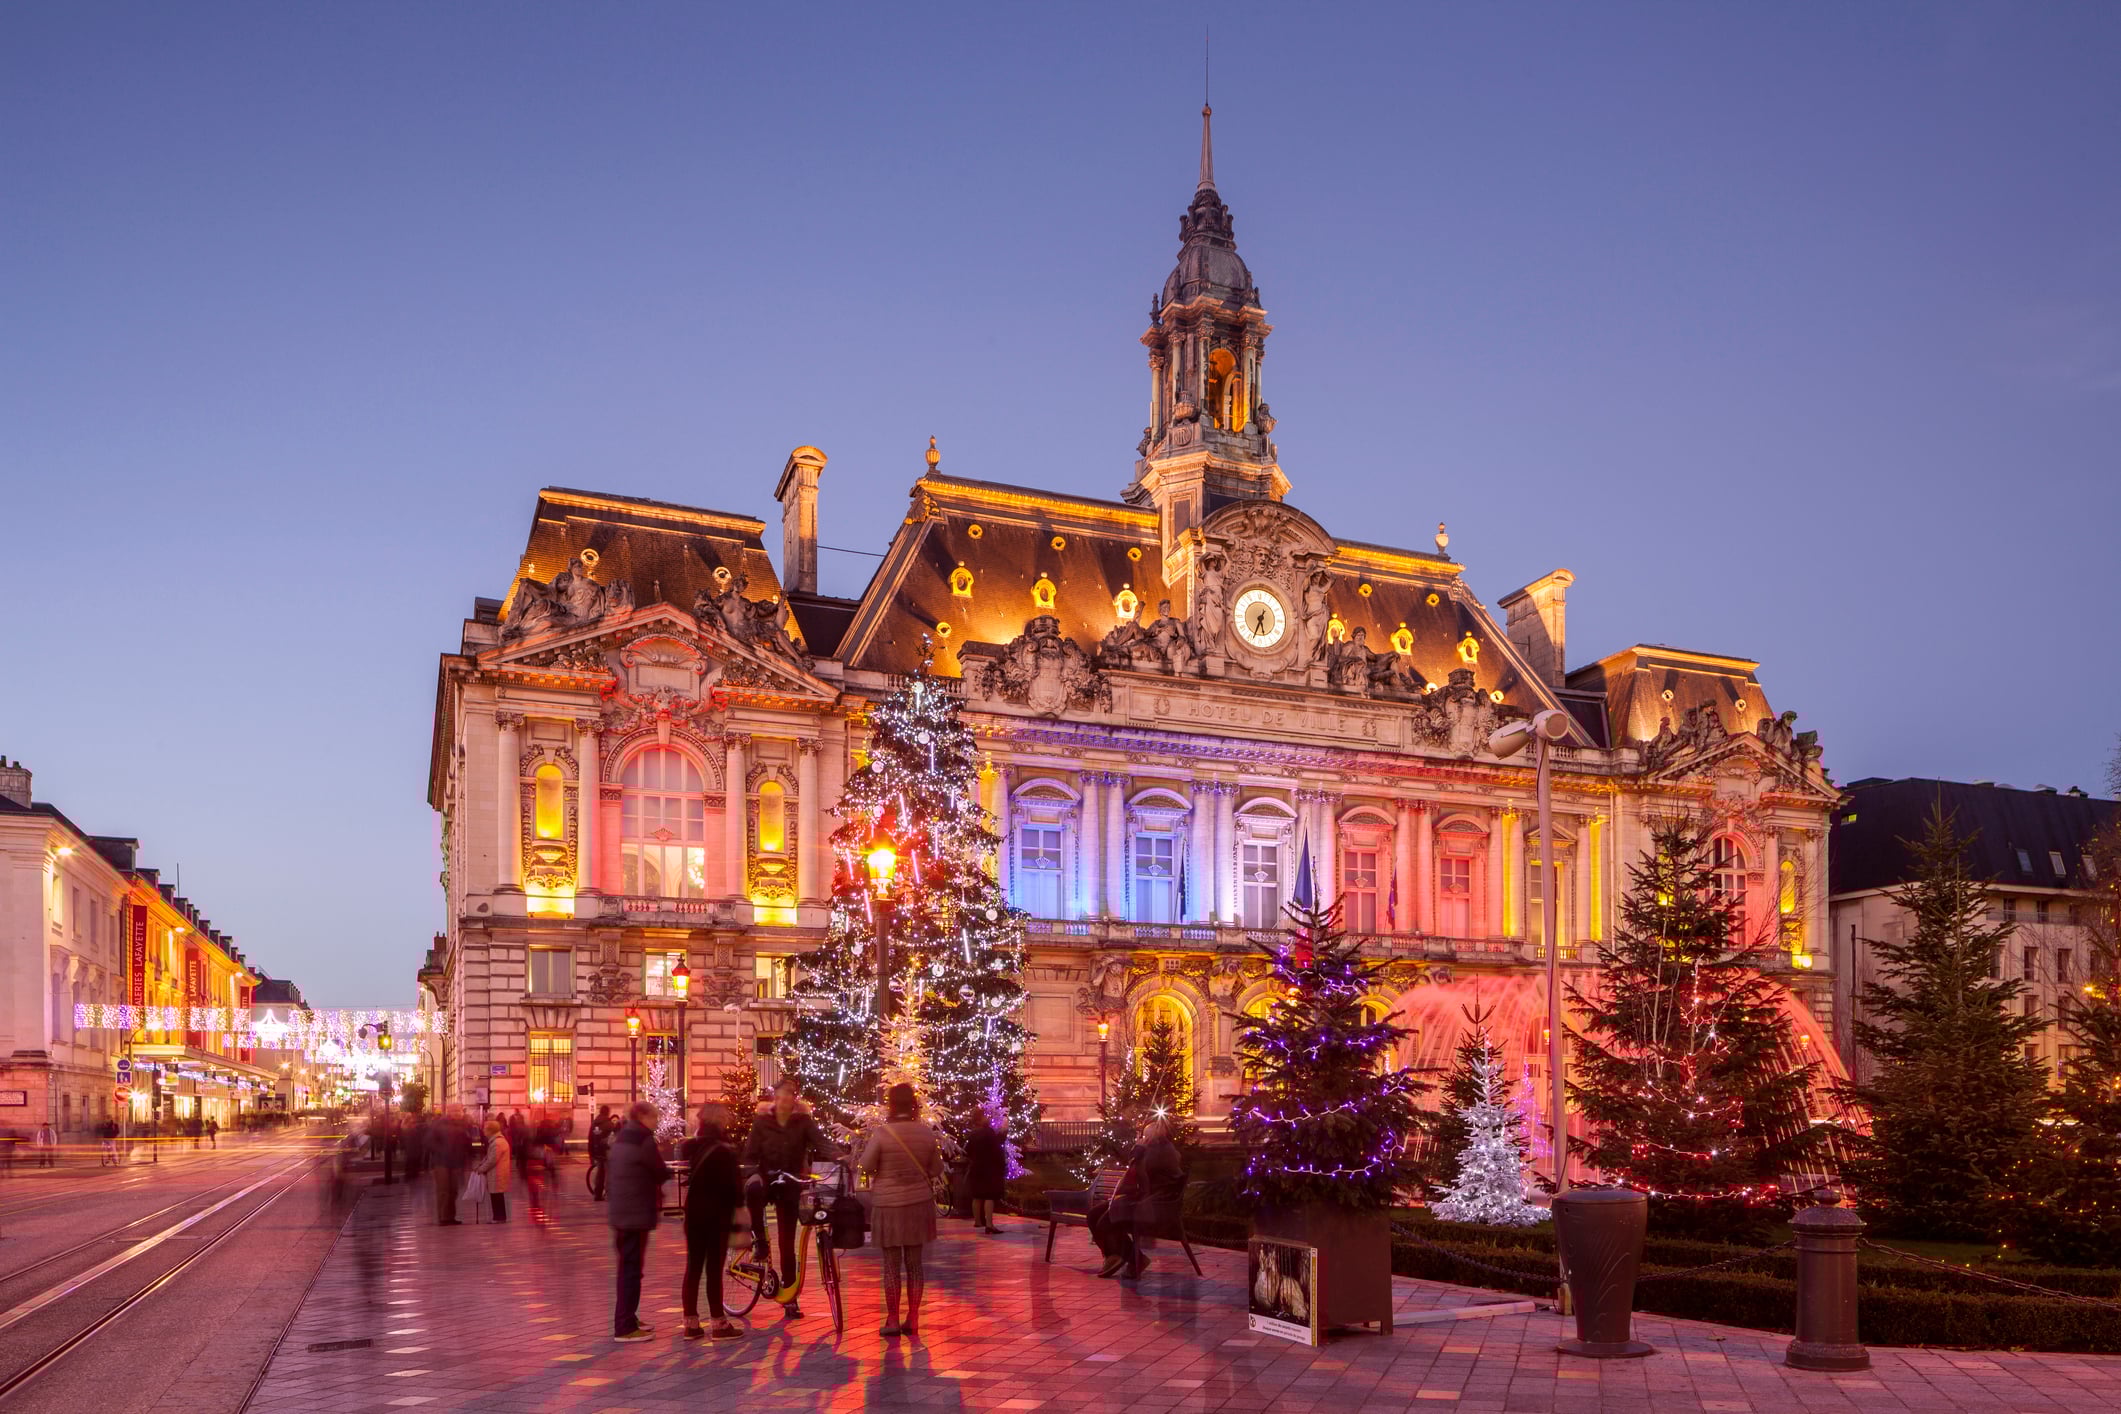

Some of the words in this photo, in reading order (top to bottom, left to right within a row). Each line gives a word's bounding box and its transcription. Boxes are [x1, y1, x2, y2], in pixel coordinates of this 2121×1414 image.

[1188, 700, 1251, 721] HOTEL
[1262, 710, 1285, 726] DE
[1298, 712, 1347, 732] VILLE
[134, 920, 144, 967] LAFAYETTE
[134, 972, 143, 1009] ALERIES
[189, 960, 197, 997] LAFAYETTE
